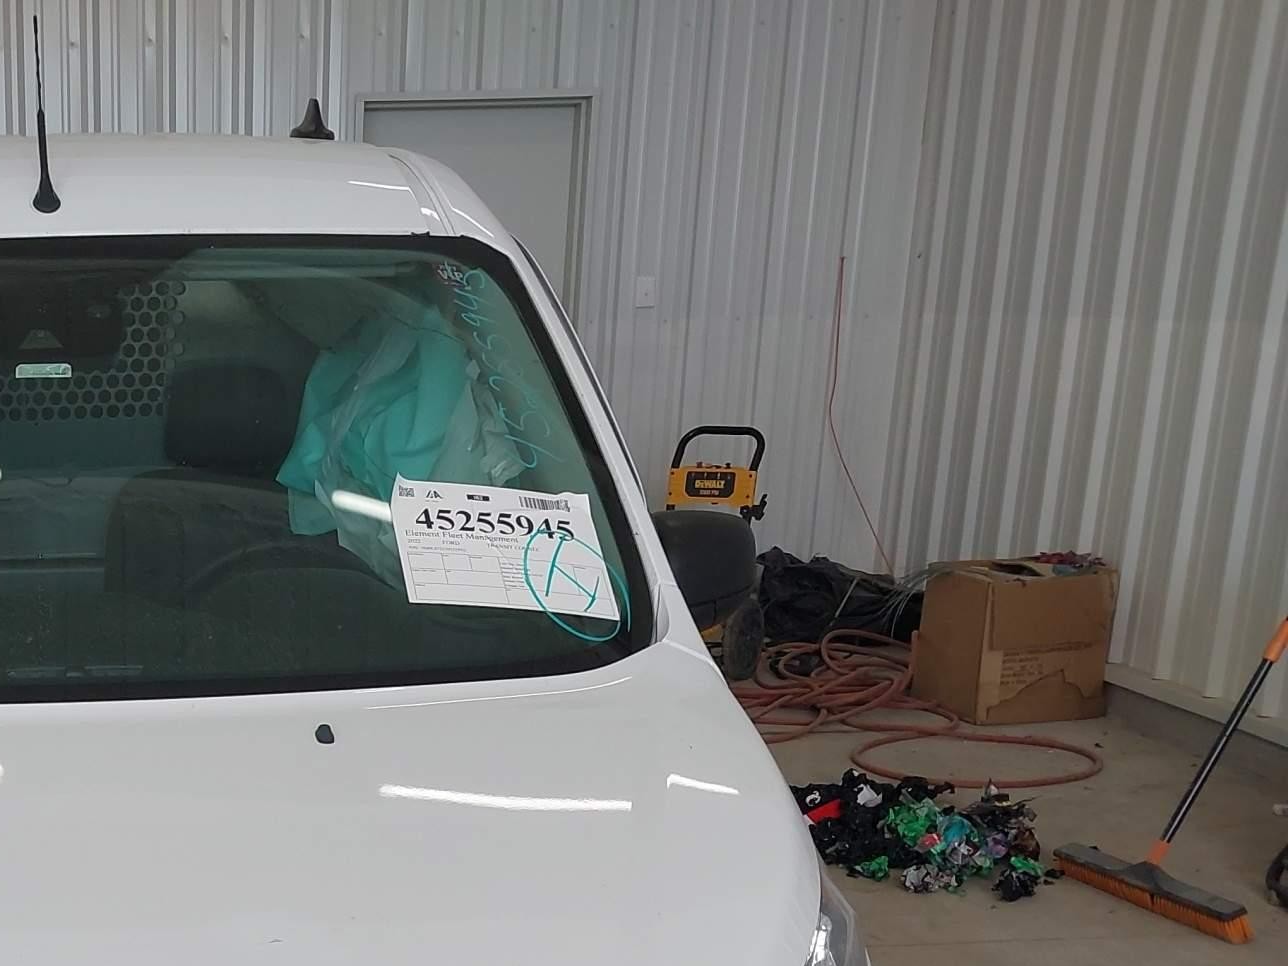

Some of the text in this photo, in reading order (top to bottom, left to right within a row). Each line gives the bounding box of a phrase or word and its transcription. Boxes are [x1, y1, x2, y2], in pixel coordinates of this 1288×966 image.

[415, 507, 575, 541] 45255945
[405, 529, 519, 544] Element Fleet Management
